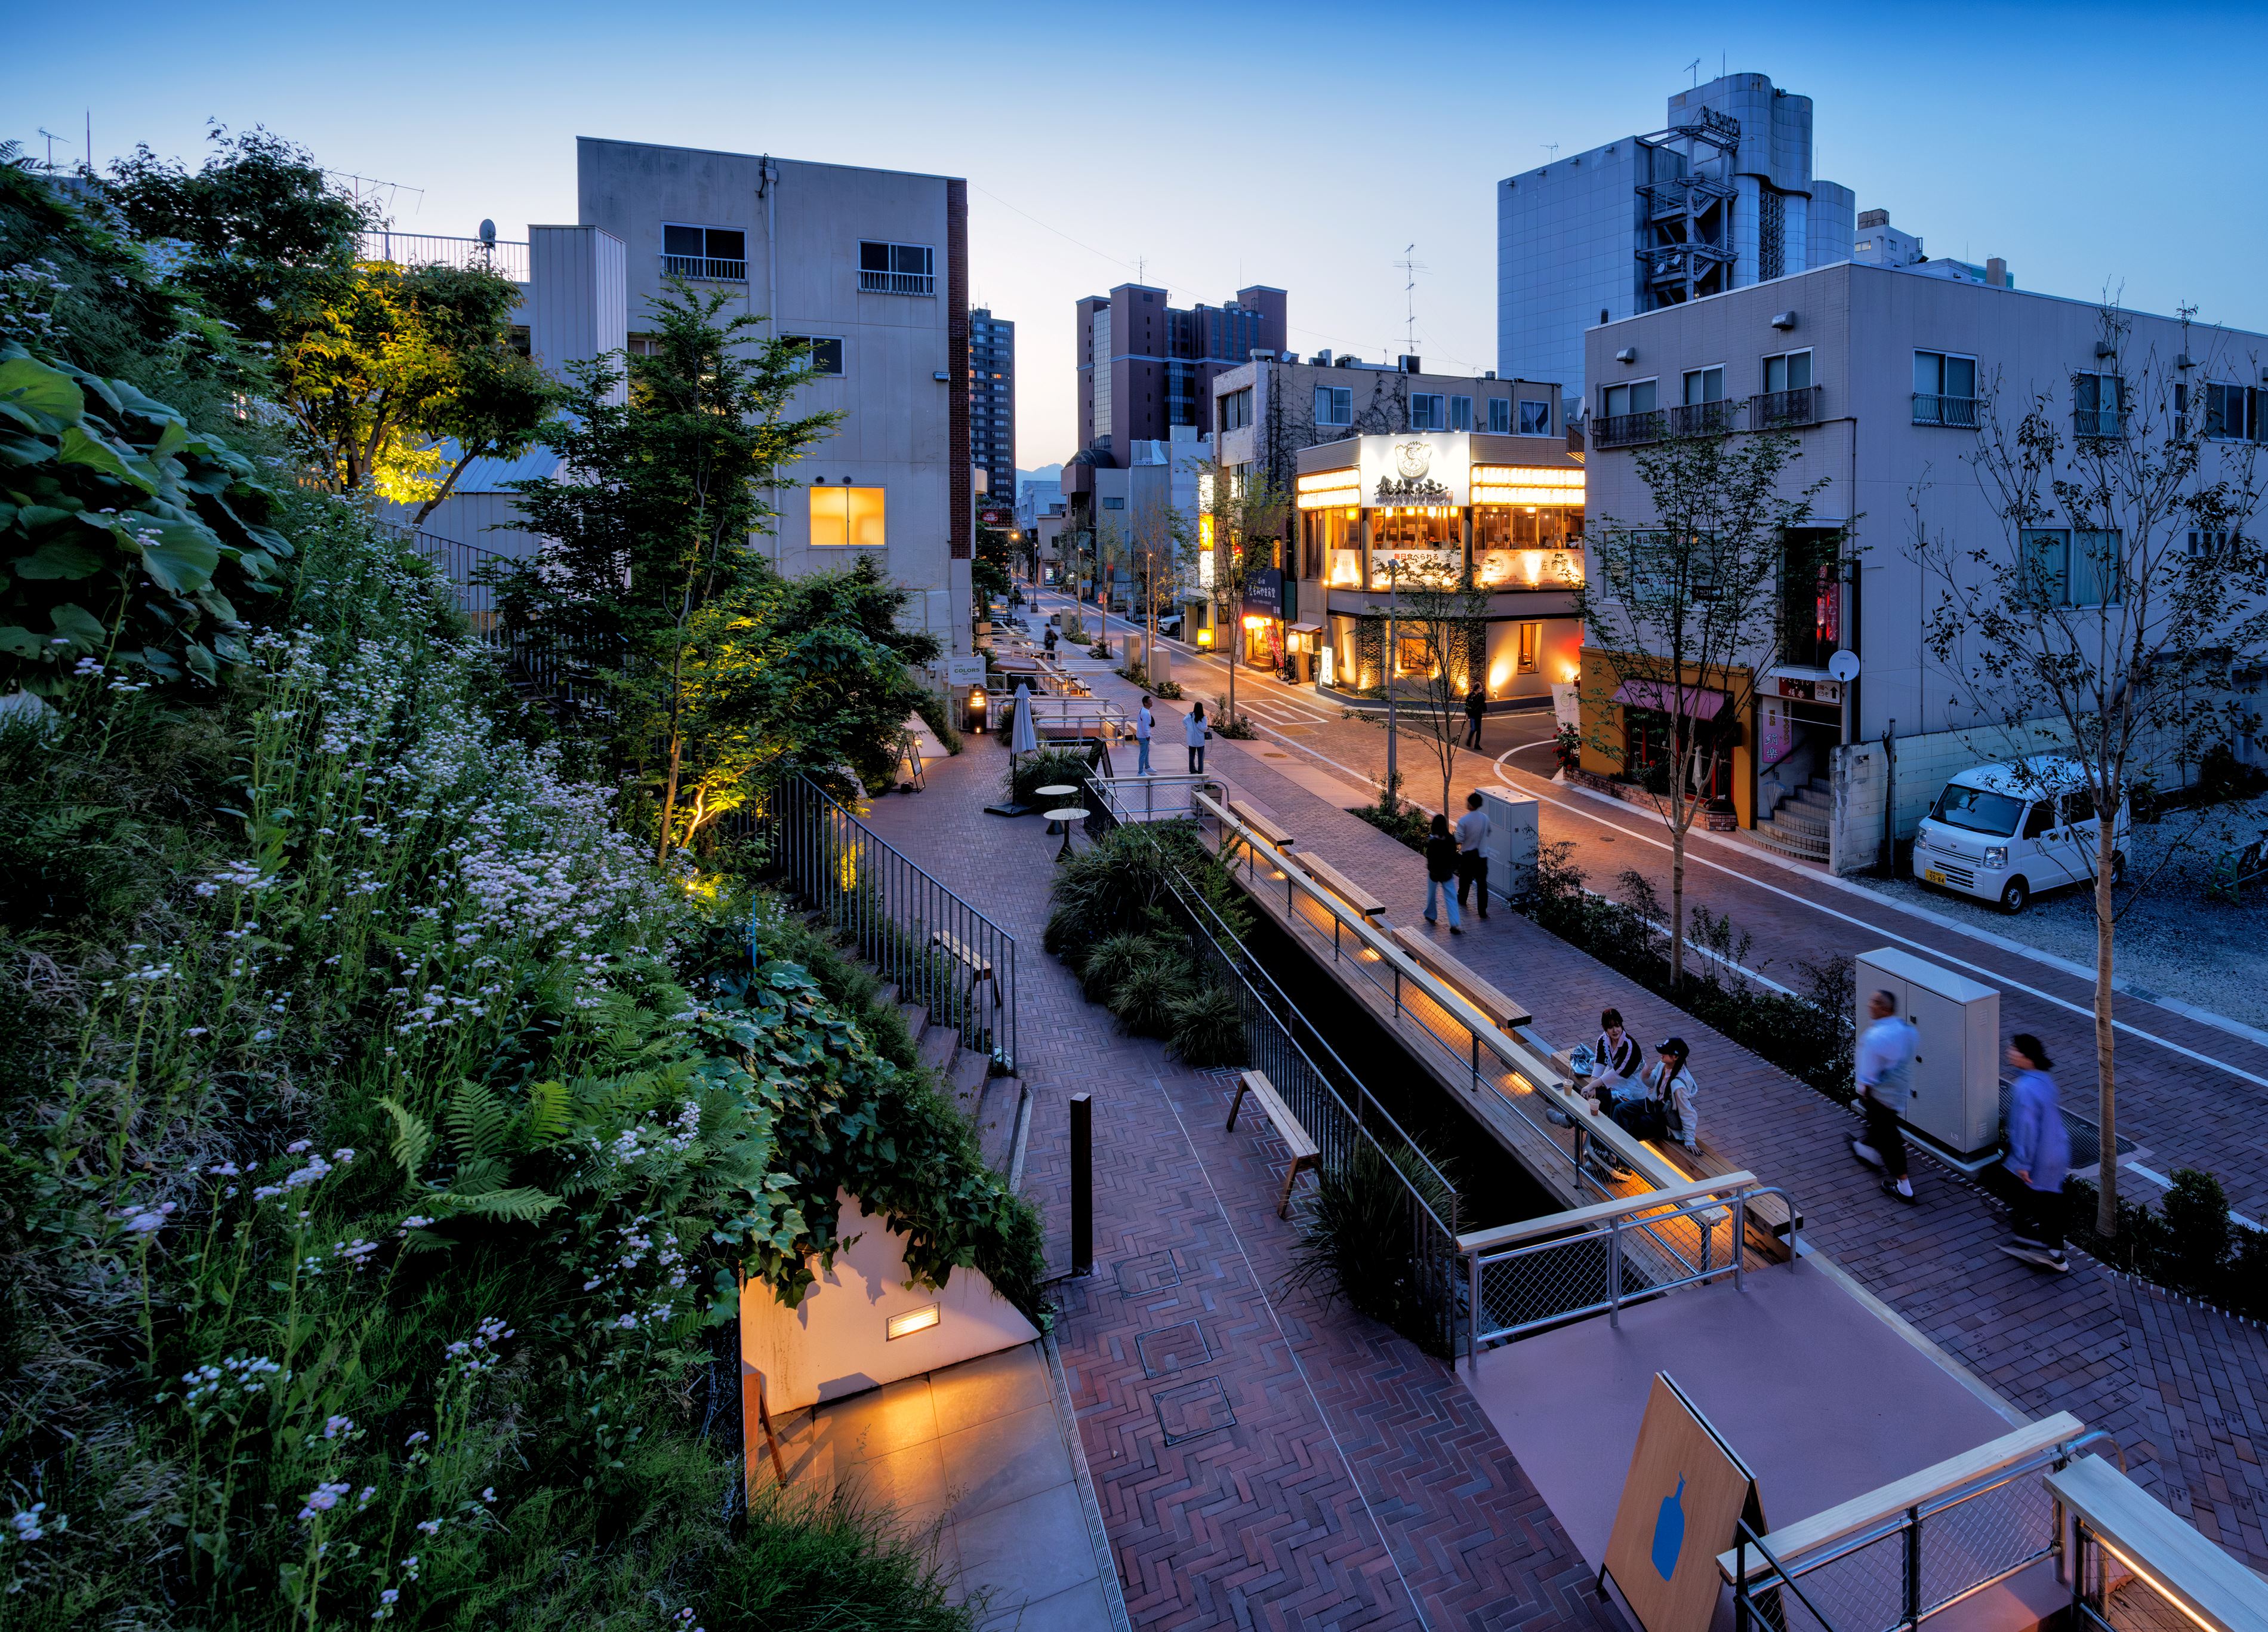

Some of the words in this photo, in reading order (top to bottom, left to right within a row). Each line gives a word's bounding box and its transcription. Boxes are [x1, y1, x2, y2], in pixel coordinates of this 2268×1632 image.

[1716, 110, 1741, 138] CHIYODA
[1765, 734, 1779, 759] 絹楽
[1930, 874, 1944, 883] 55-84
